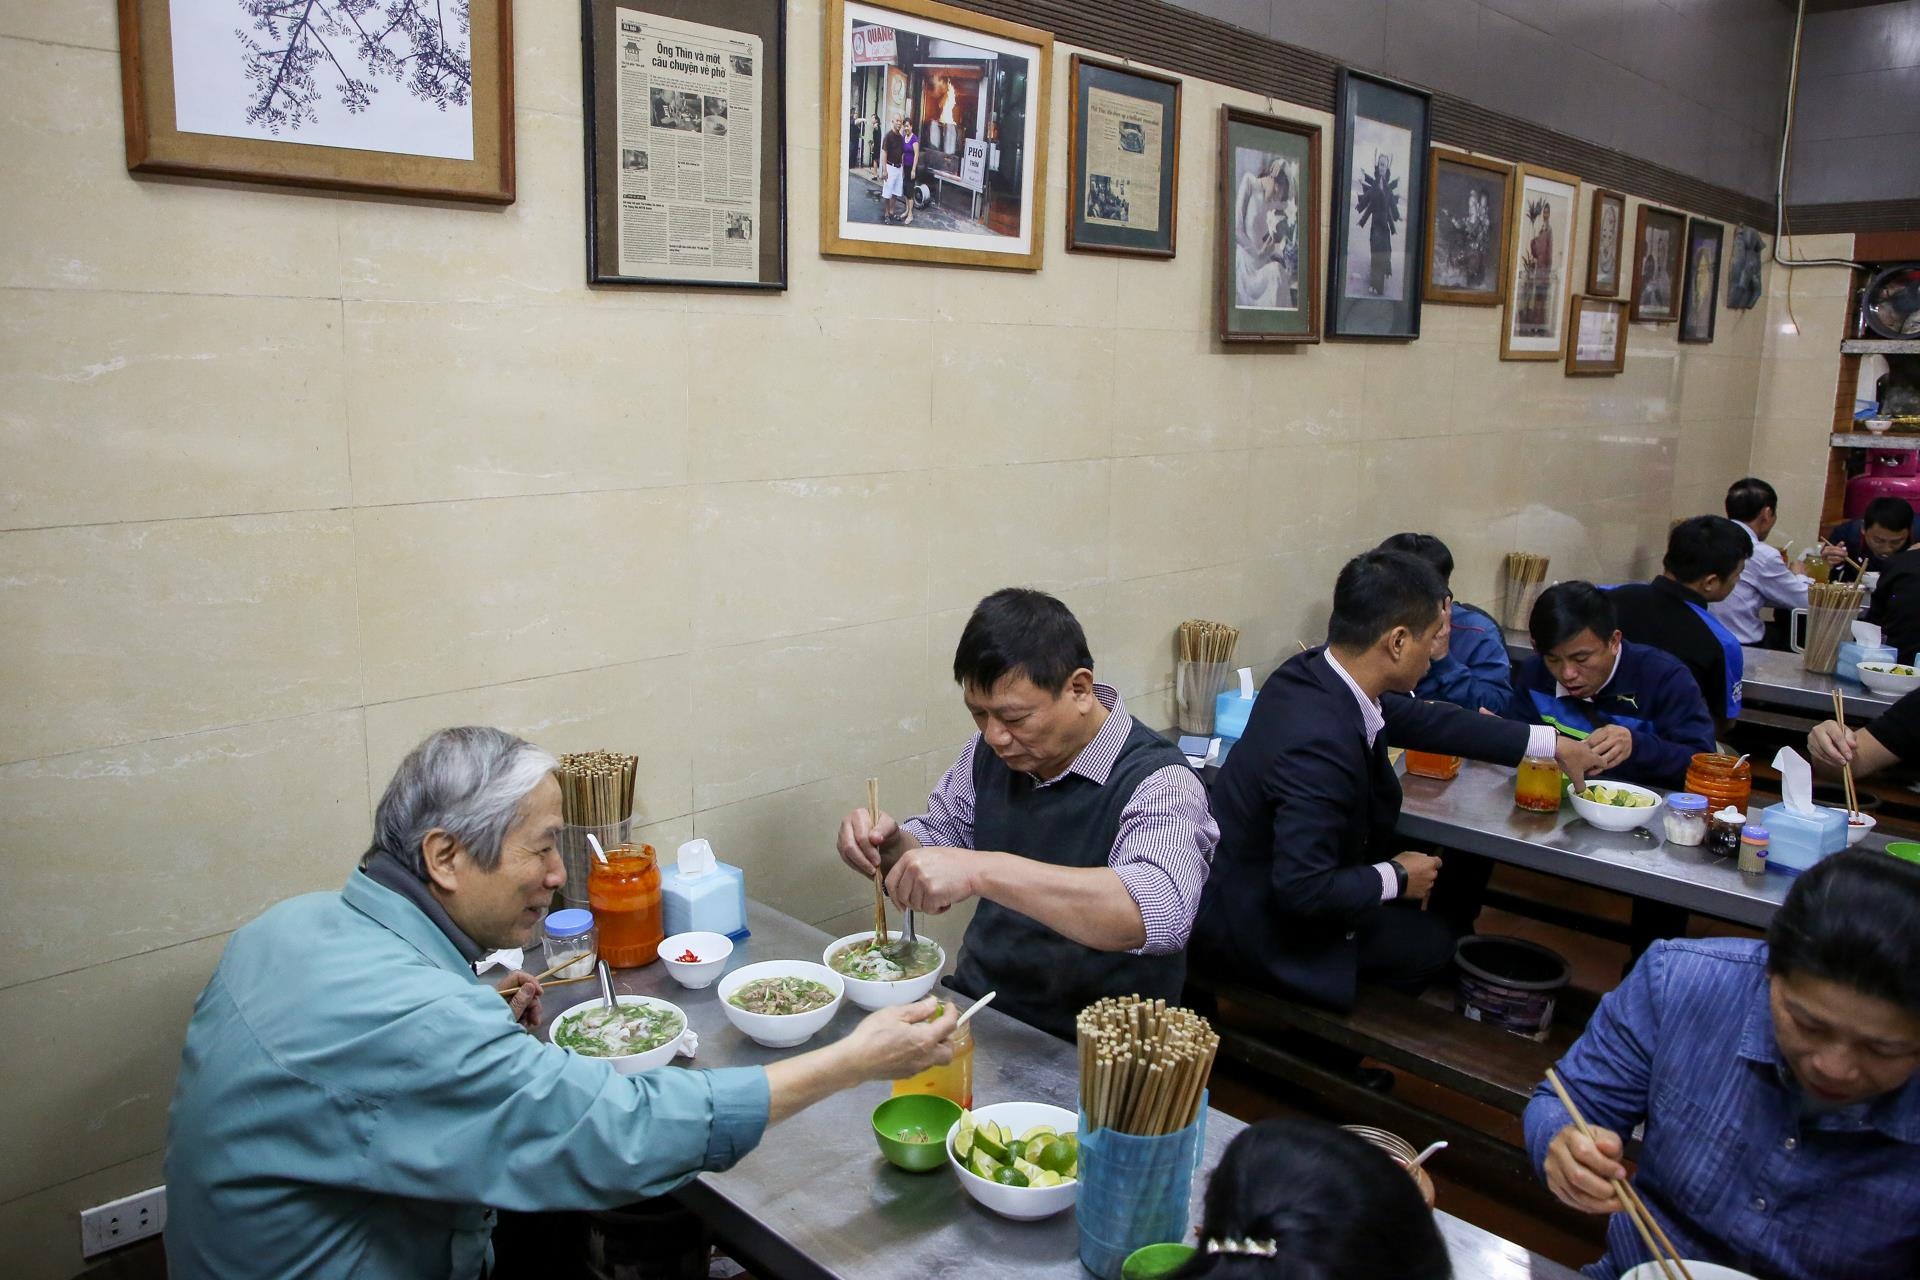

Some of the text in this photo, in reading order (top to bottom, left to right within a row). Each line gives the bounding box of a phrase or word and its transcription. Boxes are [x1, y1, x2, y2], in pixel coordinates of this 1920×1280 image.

[657, 40, 720, 66] Ông Thìn và một
[652, 56, 668, 68] câu
[670, 59, 698, 76] chuyện
[700, 63, 709, 75] về
[711, 65, 726, 78] phở
